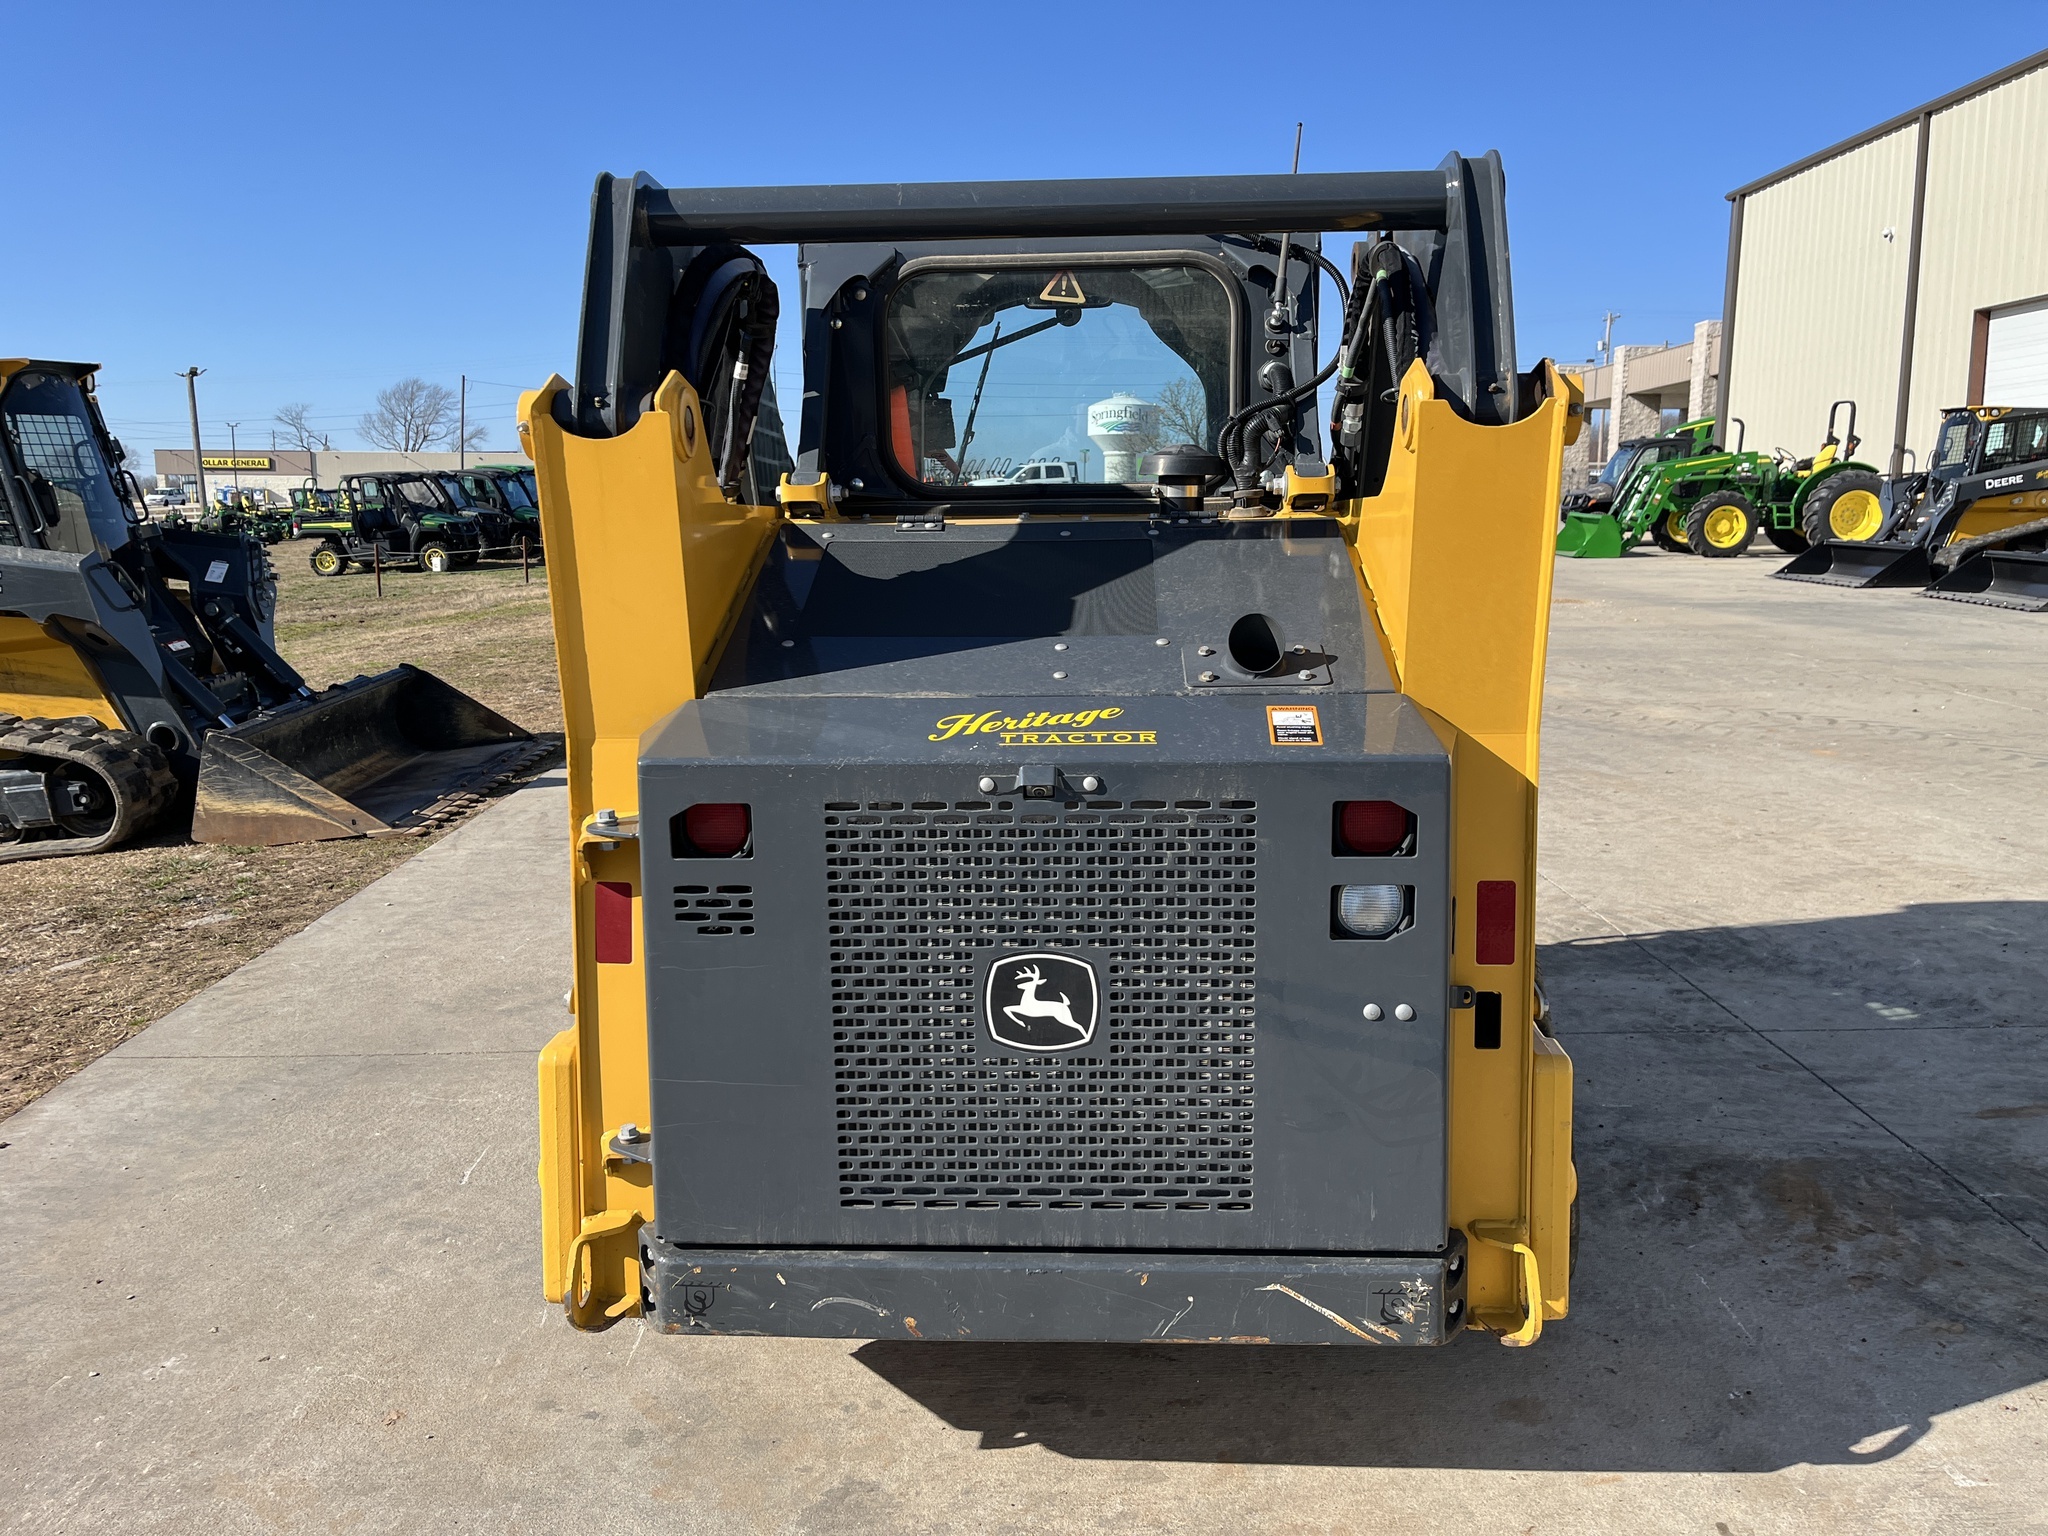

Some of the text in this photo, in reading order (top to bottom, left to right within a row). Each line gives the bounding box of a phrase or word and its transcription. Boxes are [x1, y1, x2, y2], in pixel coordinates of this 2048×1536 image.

[1091, 406, 1148, 424] Springfield
[1985, 474, 2024, 490] DEERE
[928, 707, 1124, 742] Heritage
[1000, 733, 1157, 743] TRACTOR
